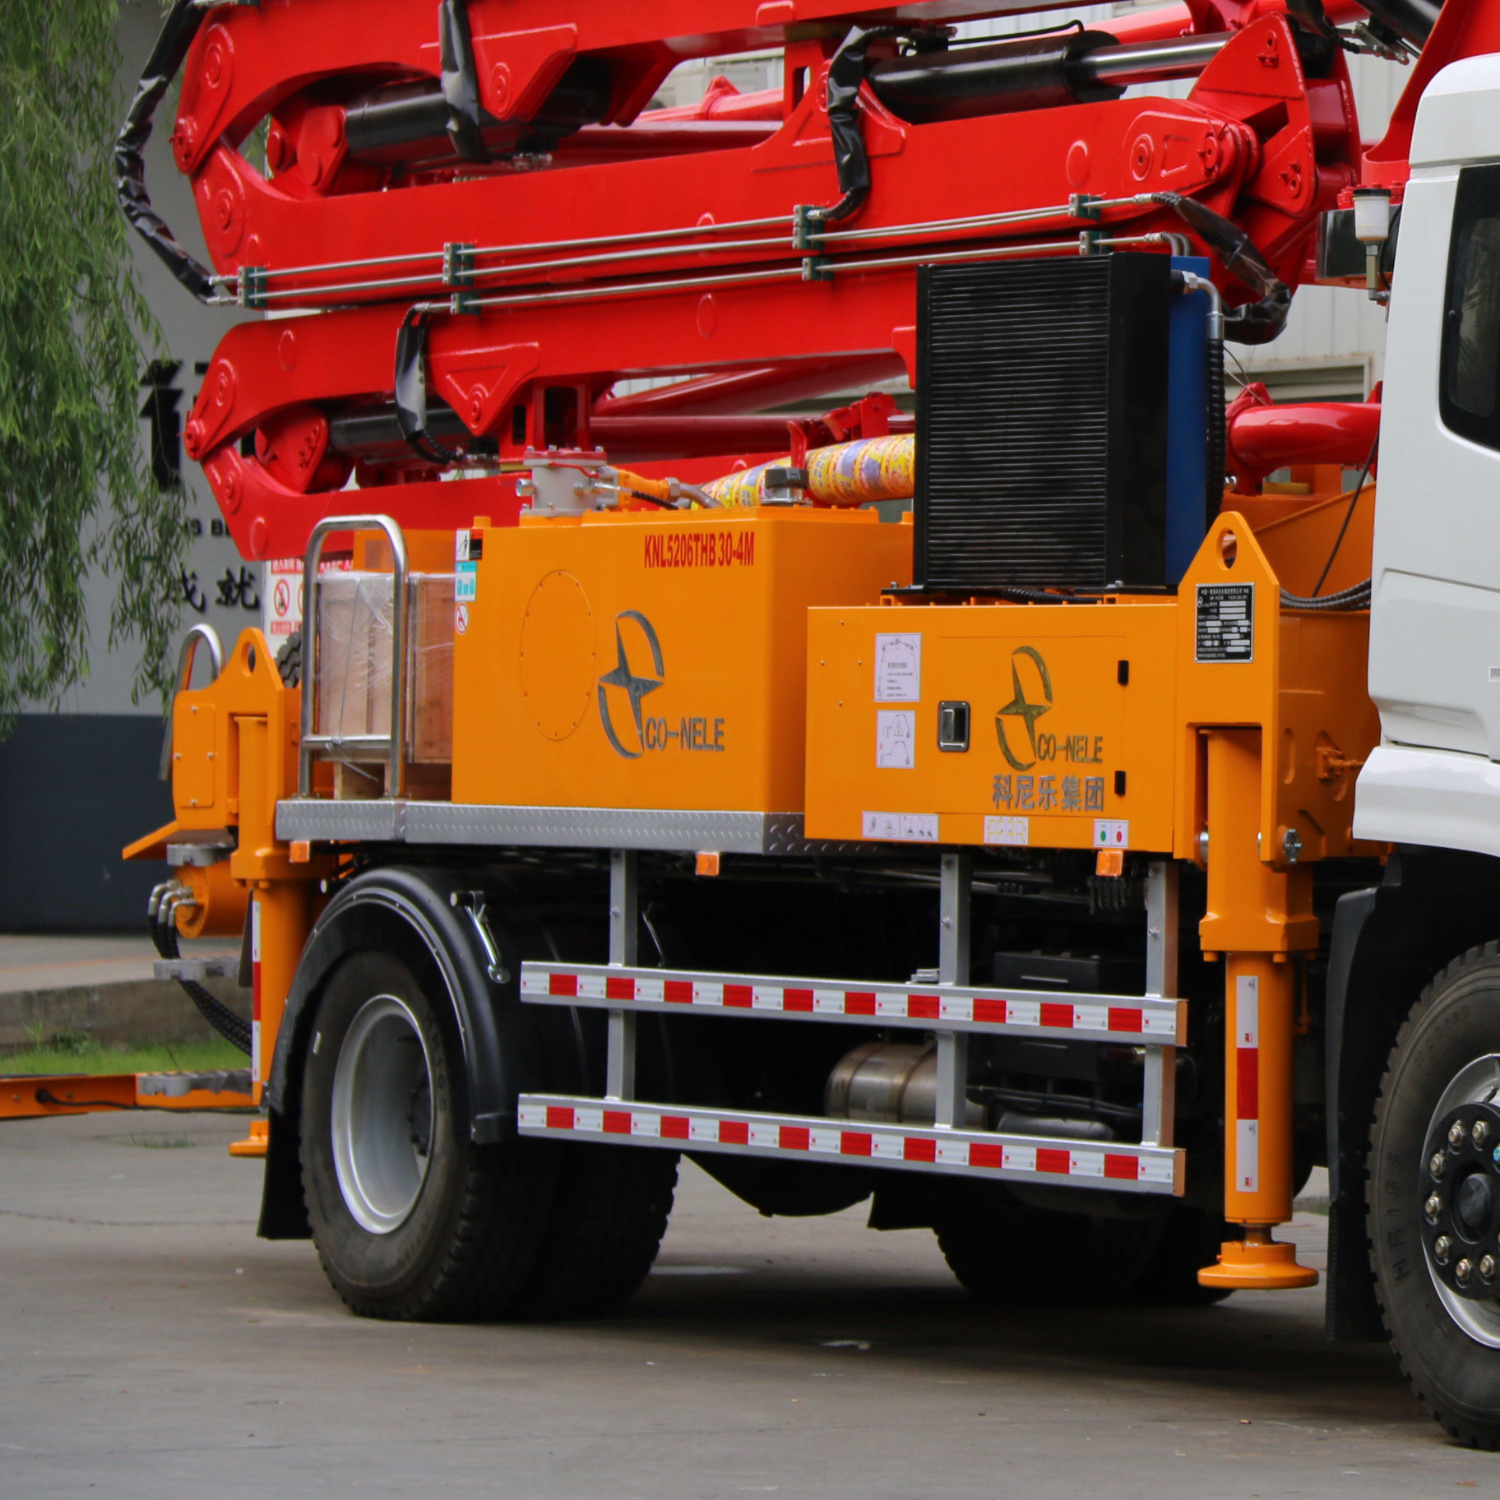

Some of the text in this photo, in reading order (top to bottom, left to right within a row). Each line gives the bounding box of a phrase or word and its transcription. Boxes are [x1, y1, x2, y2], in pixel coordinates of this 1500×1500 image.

[643, 530, 755, 569] KNL5206THB 30-4M
[644, 716, 726, 752] CO-NELE
[1036, 732, 1104, 764] CO-NELE
[991, 773, 1105, 812] 科尼乐集团
